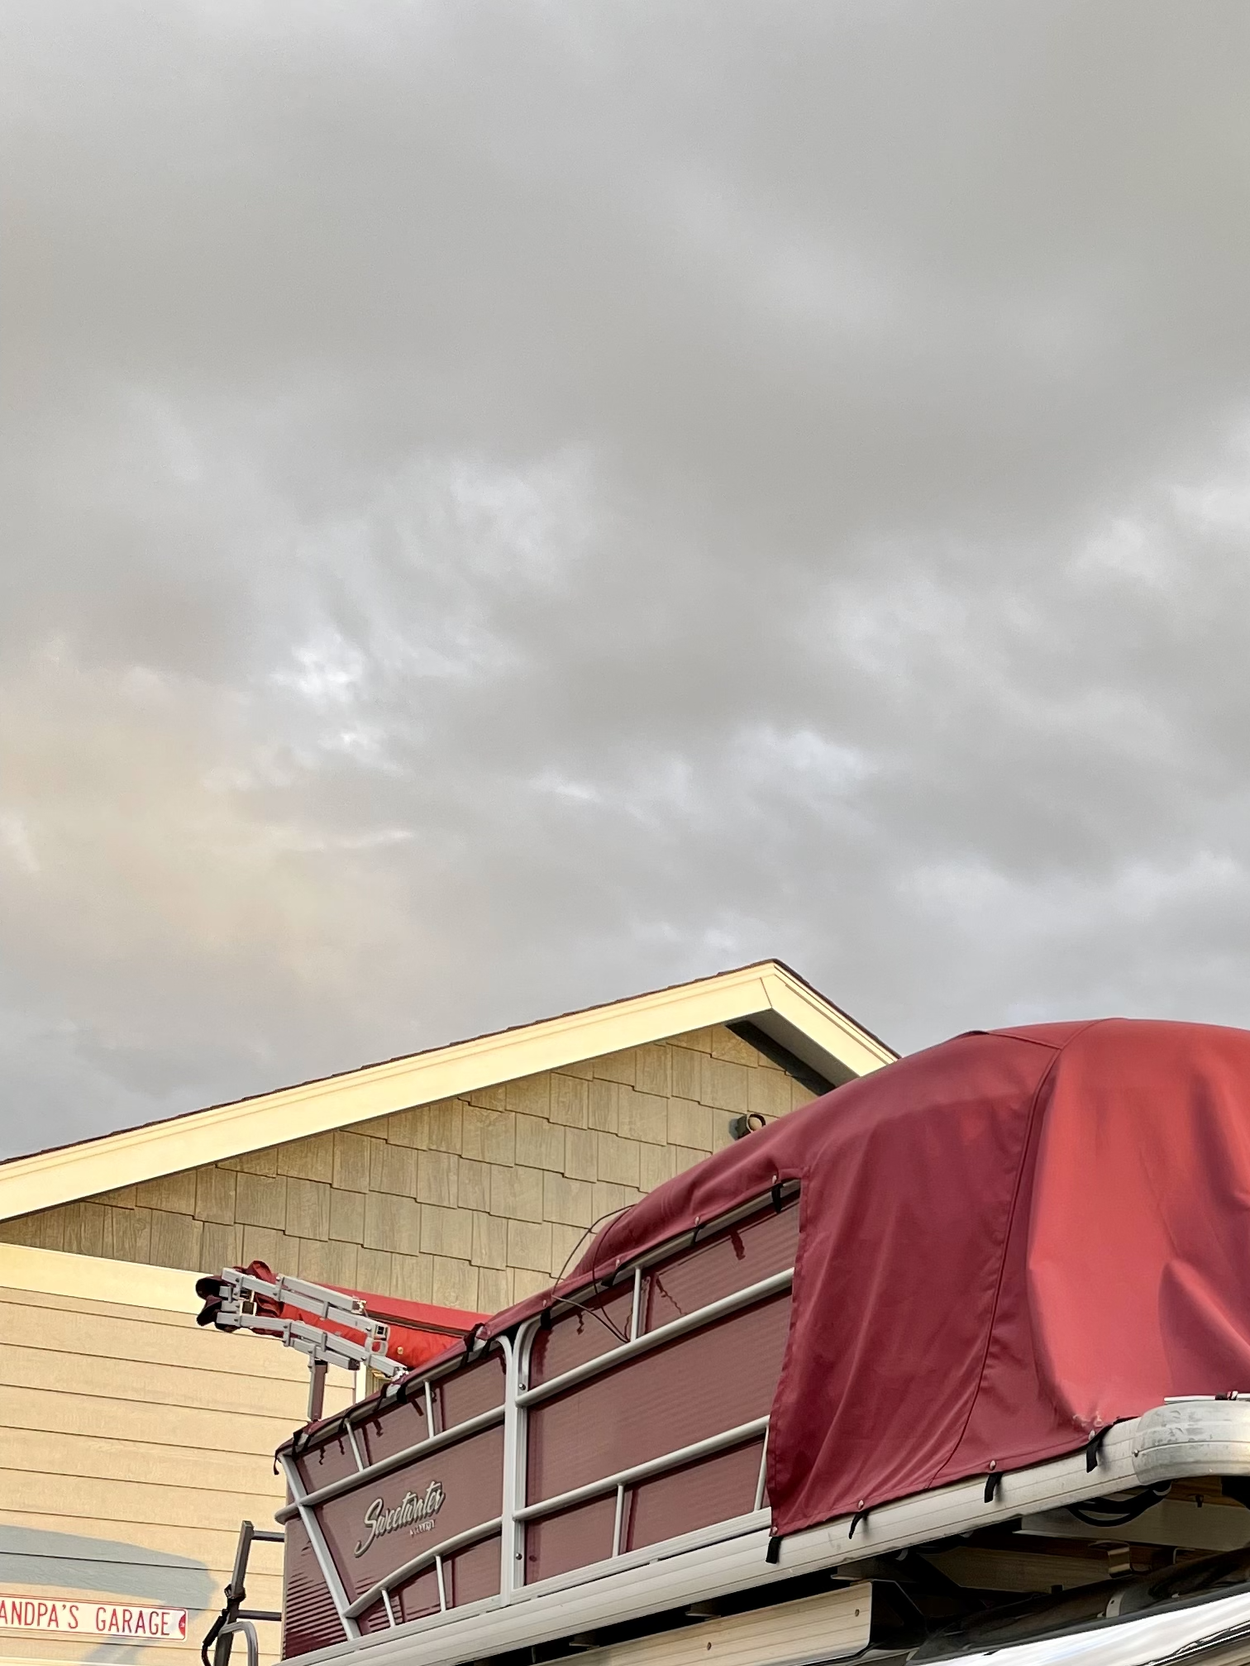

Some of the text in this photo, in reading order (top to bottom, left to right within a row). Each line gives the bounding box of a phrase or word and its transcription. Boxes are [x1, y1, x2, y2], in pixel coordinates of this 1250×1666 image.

[354, 1480, 446, 1558] Sweetwater
[0, 1600, 170, 1636] ANDPA'S GARAGE
